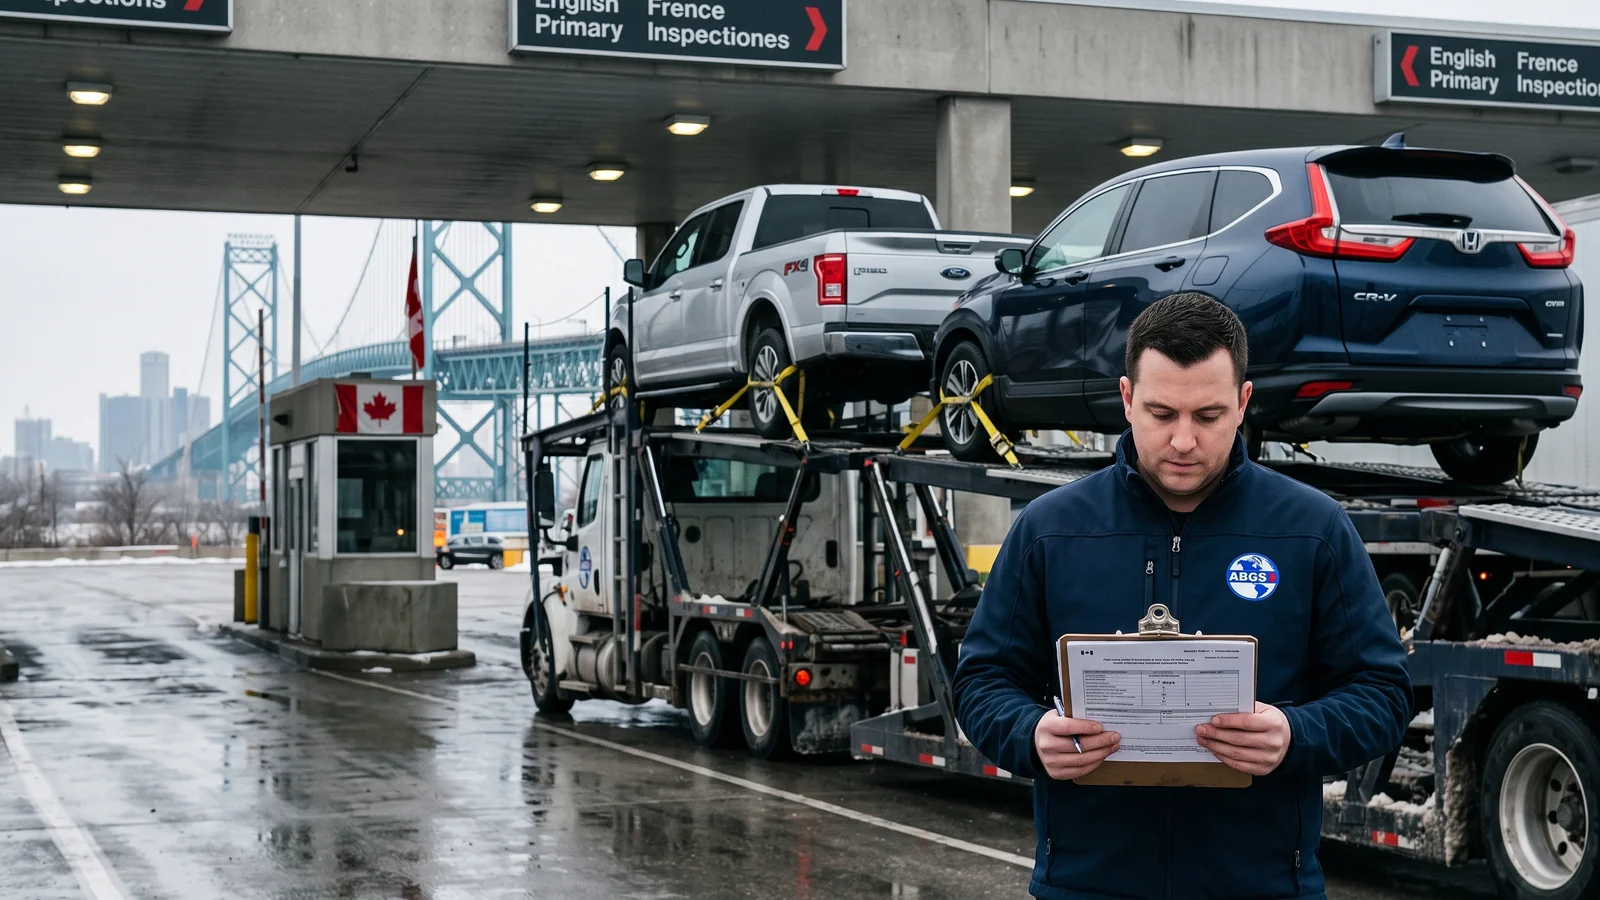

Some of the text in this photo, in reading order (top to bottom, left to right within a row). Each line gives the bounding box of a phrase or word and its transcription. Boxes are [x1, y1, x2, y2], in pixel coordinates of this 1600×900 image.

[648, 0, 726, 20] Frence
[535, 13, 624, 43] Primary
[647, 21, 791, 49] Inspectiones
[1430, 46, 1496, 70] English
[1517, 51, 1579, 73] Frence
[1430, 69, 1500, 95] Primary
[1517, 74, 1600, 98] Inspectio
[1353, 292, 1397, 302] CR-V
[1229, 571, 1268, 583] ABGS
